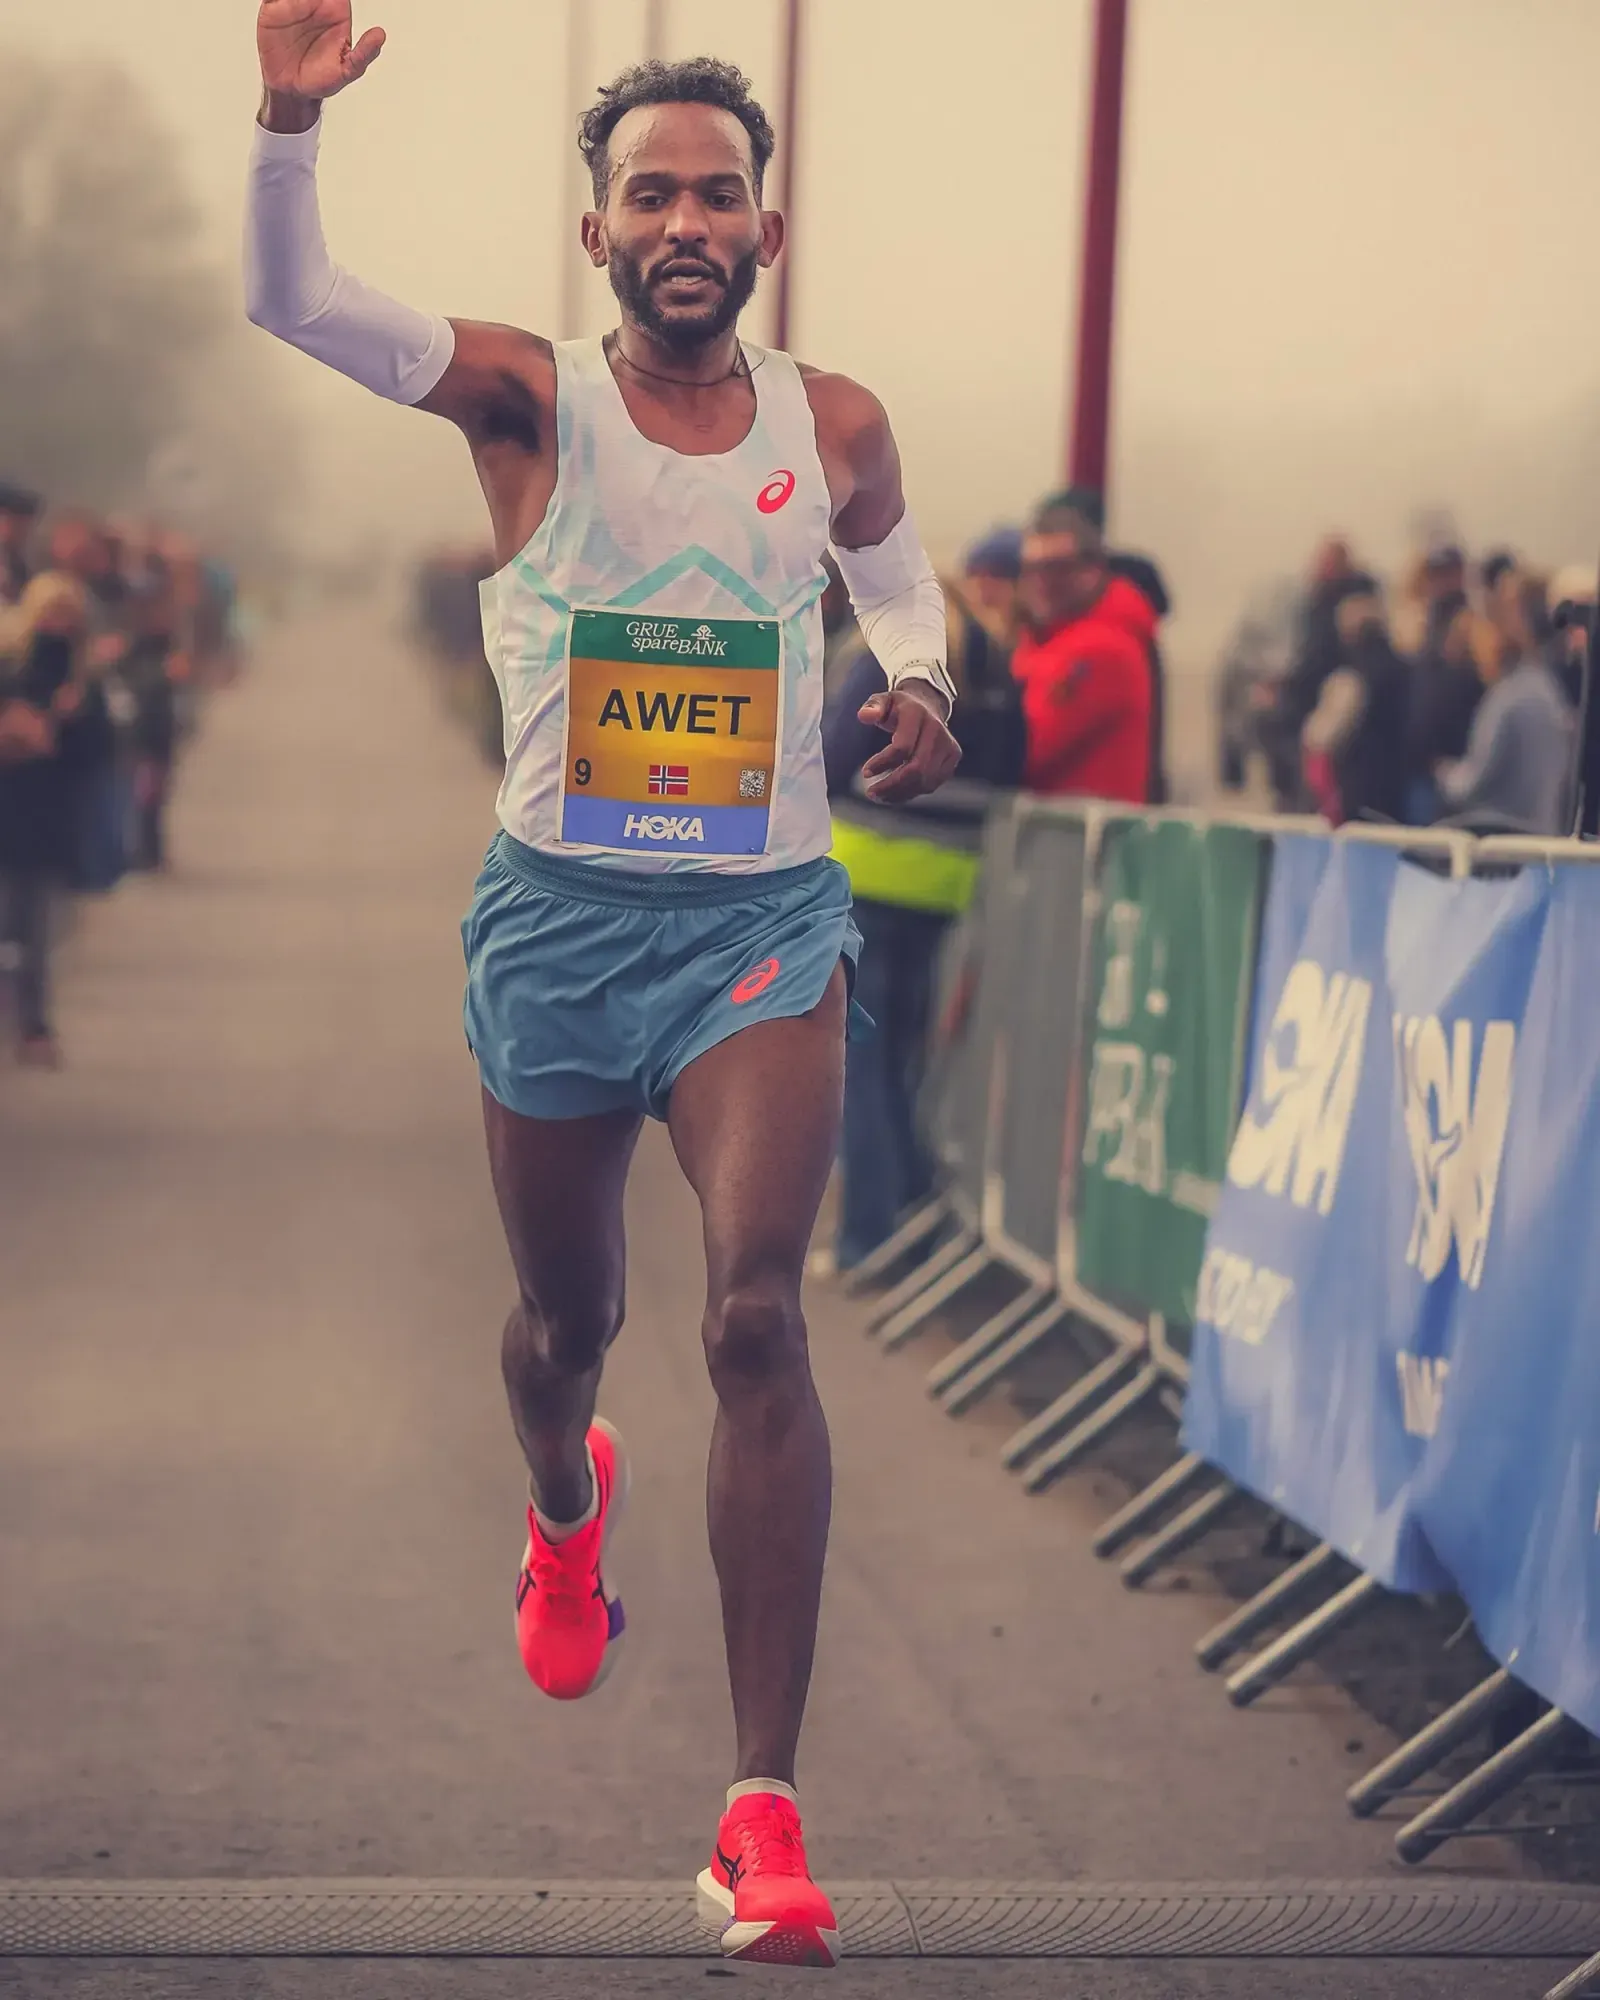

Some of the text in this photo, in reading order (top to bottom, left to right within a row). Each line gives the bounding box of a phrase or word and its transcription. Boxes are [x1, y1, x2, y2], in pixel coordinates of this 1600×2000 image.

[626, 621, 679, 638] GRUE
[631, 636, 728, 656] spareBANK
[598, 688, 751, 735] AWET
[574, 757, 592, 785] 9
[624, 813, 705, 841] HOKA
